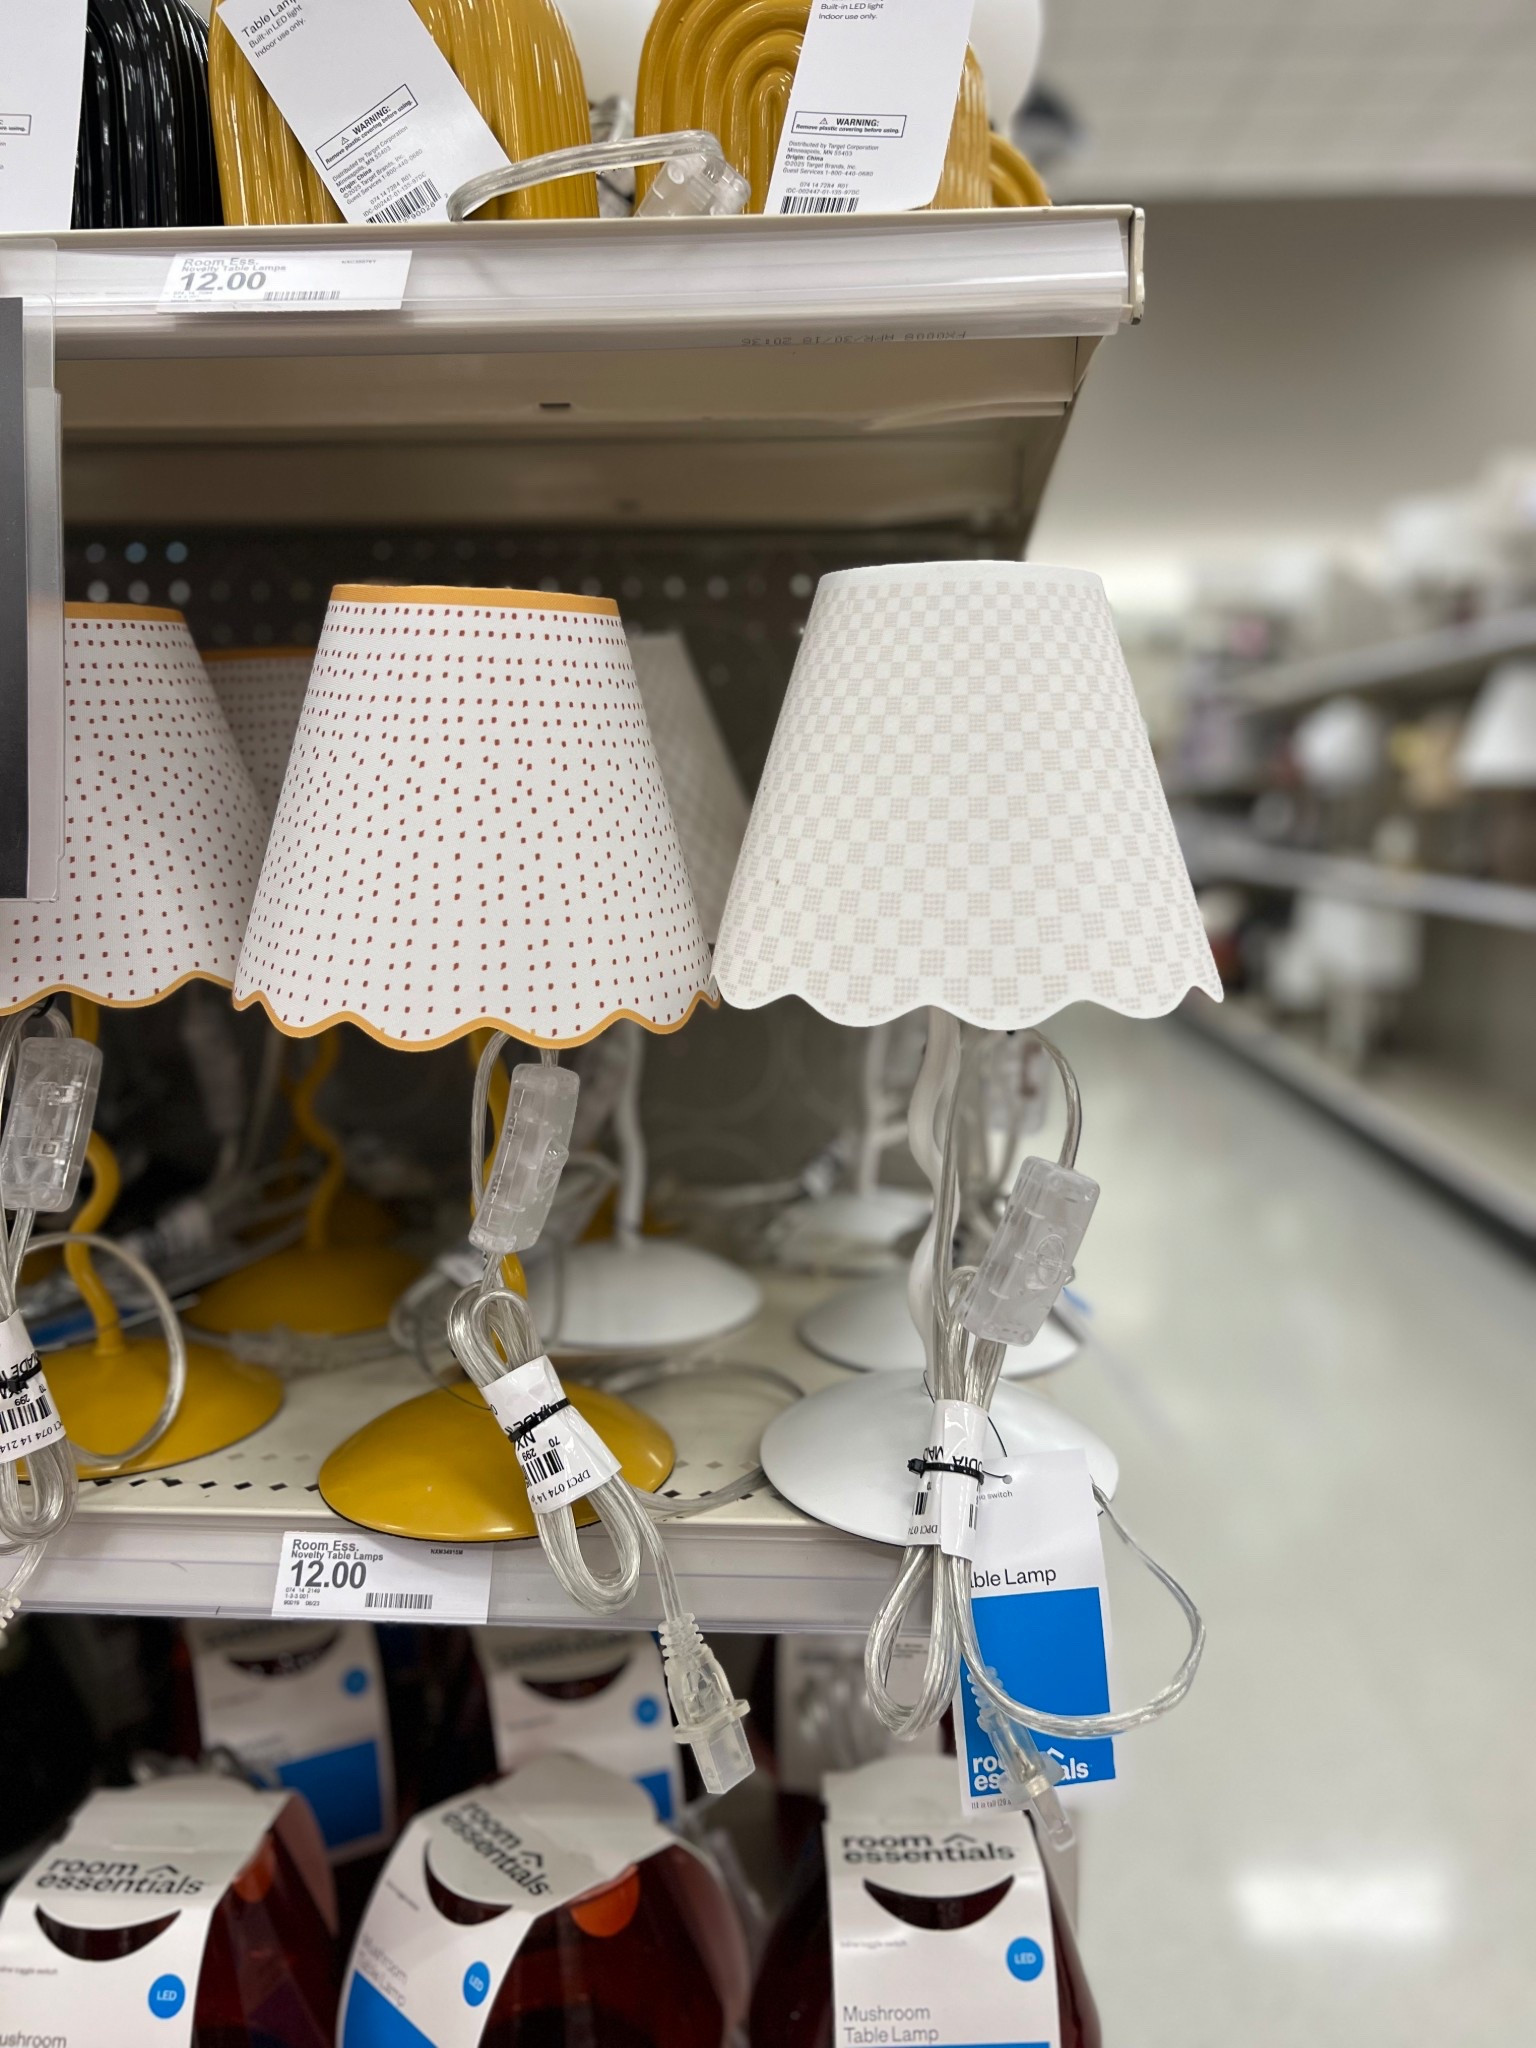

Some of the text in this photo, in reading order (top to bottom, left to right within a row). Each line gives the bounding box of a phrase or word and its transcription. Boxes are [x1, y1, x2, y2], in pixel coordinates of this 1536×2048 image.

[241, 13, 271, 38] Table
[248, 4, 303, 49] Built-in LED light
[860, 13, 878, 21] only.
[255, 18, 307, 58] Indoor use only.
[351, 105, 391, 135] WARNING:
[836, 118, 880, 127] WARNING:
[325, 100, 413, 165] Remove plastic covering before using.
[332, 126, 408, 182] Distributed by Target Corporation
[365, 157, 375, 166] MN
[375, 146, 392, 160] 55403
[820, 142, 827, 150] by
[828, 143, 846, 151] Target
[786, 154, 805, 162] Origin:
[339, 168, 373, 194] Origin: China
[360, 172, 377, 187] Target
[346, 194, 362, 205] Guest
[360, 179, 382, 196] Services
[369, 196, 381, 205] 074
[380, 190, 388, 199] 14
[181, 265, 220, 274] Novelty
[256, 264, 287, 273] Lamps
[183, 257, 260, 267] Room Ess.
[180, 272, 267, 291] 12.00
[14, 1393, 31, 1407] 299
[20, 1434, 32, 1446] 14
[35, 1426, 54, 1440] 074
[521, 1435, 561, 1462] 70 299
[567, 1469, 592, 1490] DPCI
[536, 1492, 547, 1503] 14
[548, 1482, 566, 1499] 074
[987, 1489, 1013, 1500] switch
[292, 1539, 360, 1552] Room Ess.
[291, 1550, 384, 1562] Novelty Table Lamps
[291, 1559, 367, 1589] 12.00
[1004, 1568, 1057, 1587] Lamp
[460, 1801, 524, 1857] room
[842, 1834, 933, 1849] room
[441, 1810, 553, 1897] essentials
[843, 1842, 1016, 1864] essentials
[49, 1858, 139, 1878] room
[35, 1872, 205, 1896] essentials
[1014, 1953, 1036, 1965] LED
[469, 1973, 485, 1993] LED
[156, 1989, 178, 2002] LED
[843, 2005, 931, 2022] Mushroom
[844, 2026, 940, 2046] Table Lamp
